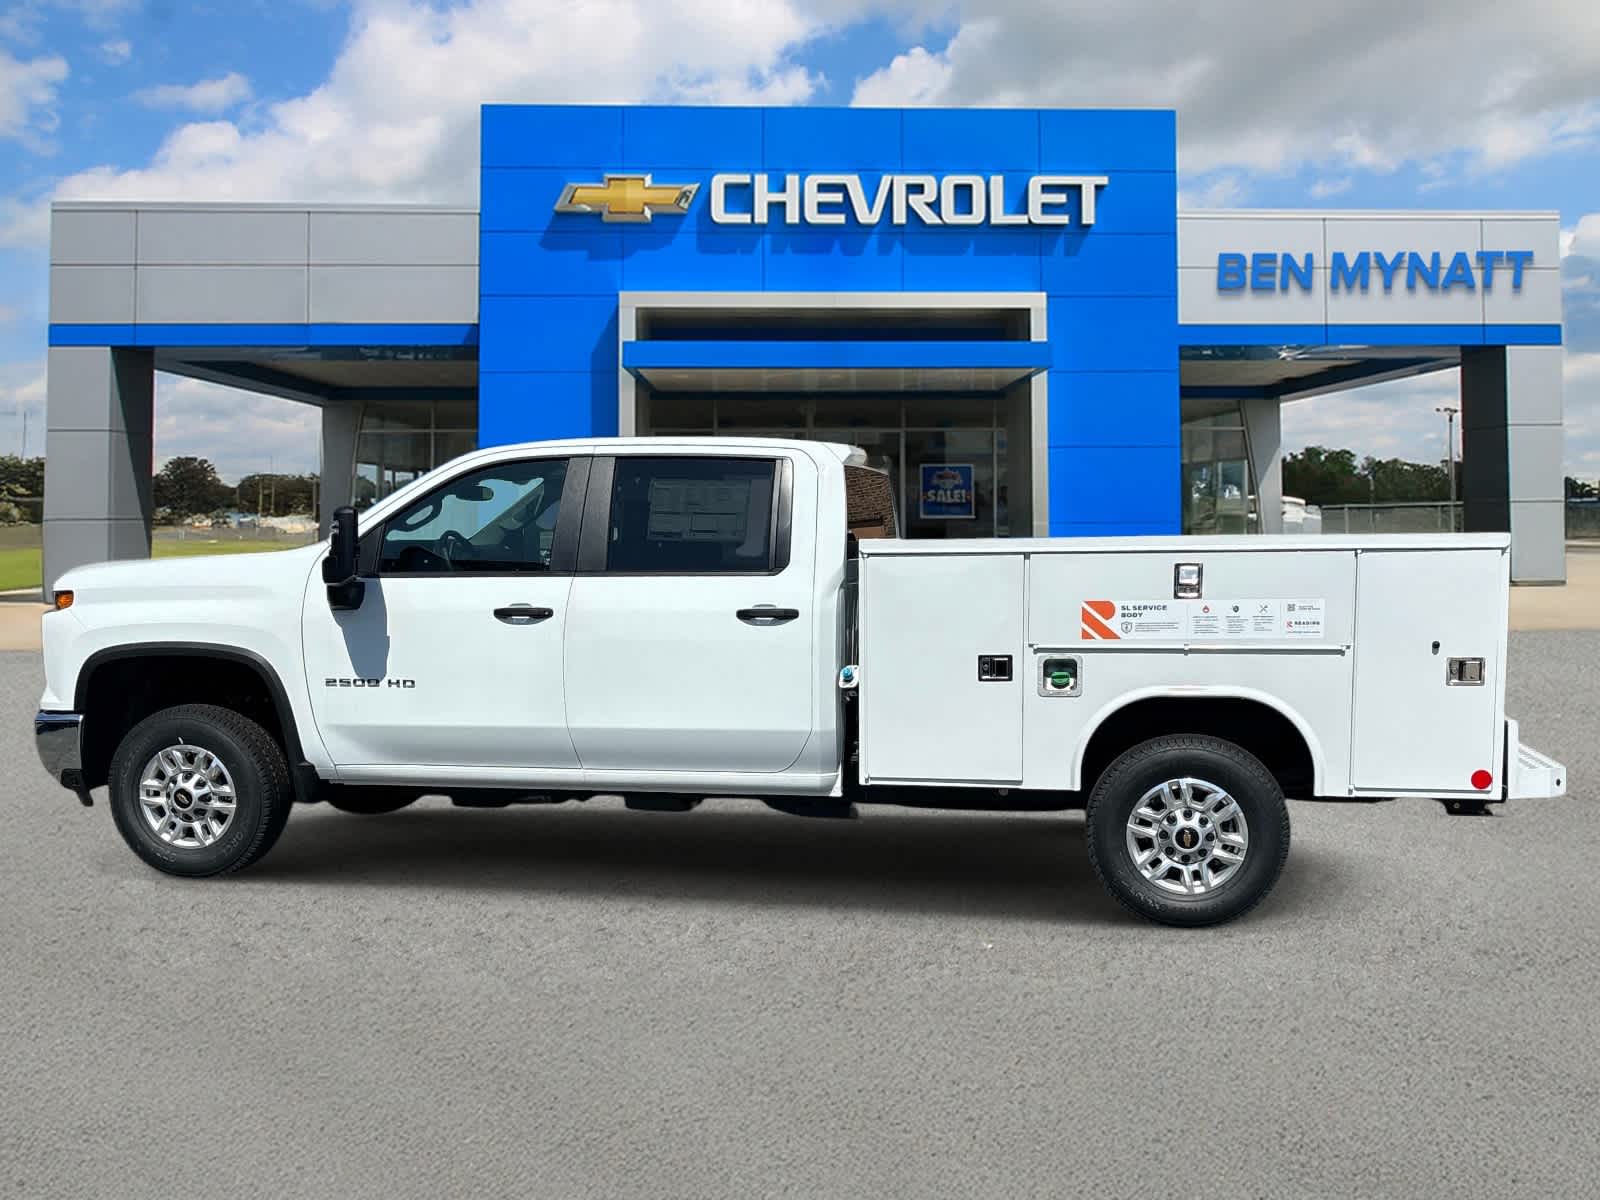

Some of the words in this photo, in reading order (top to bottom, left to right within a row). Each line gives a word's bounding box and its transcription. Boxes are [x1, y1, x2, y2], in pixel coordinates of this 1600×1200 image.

[709, 173, 1109, 226] CHEVROLET
[1216, 252, 1314, 291] BEN
[1329, 250, 1535, 291] MYNATT
[927, 489, 967, 503] SALE!
[324, 678, 381, 688] 2500
[387, 679, 416, 689] HD
